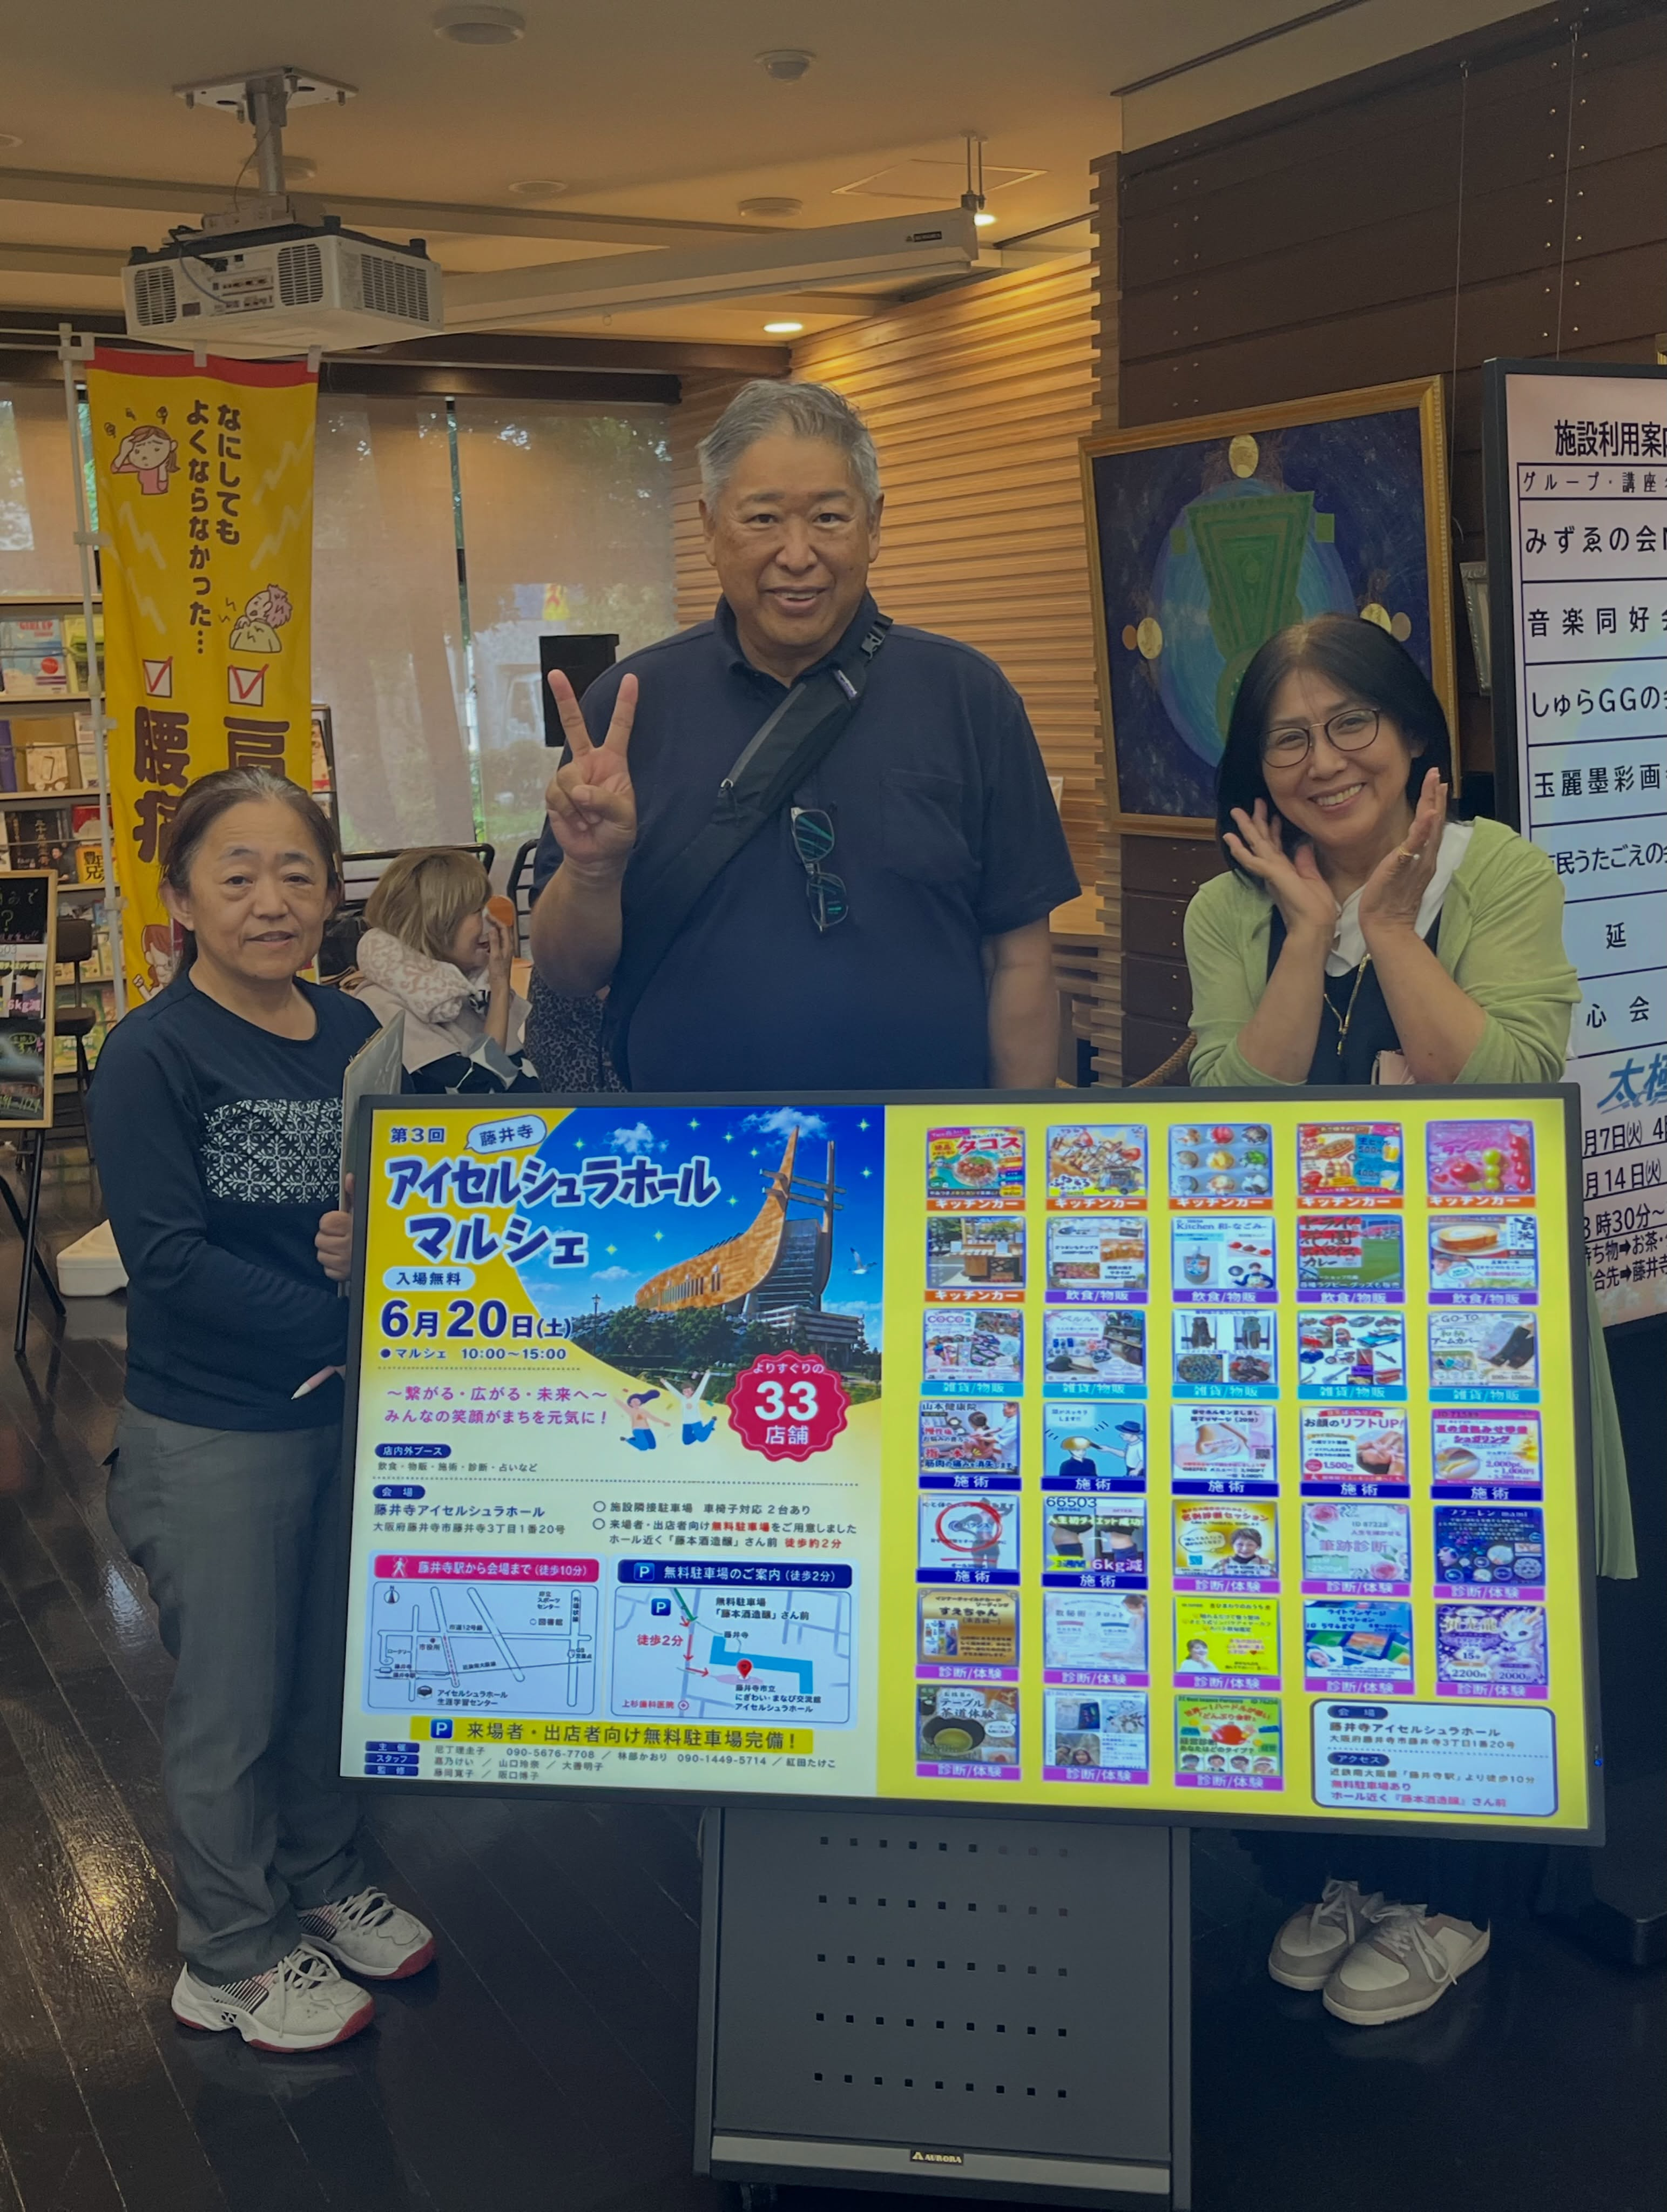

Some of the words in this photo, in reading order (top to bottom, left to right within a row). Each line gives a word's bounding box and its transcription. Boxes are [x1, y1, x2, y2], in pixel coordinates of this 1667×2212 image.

[1554, 419, 1667, 458] 施設利用案
[217, 404, 241, 546] なにしても
[1523, 471, 1667, 494] グループ・講座
[1532, 685, 1667, 718] しゅらGGの
[1534, 763, 1667, 799] 玉麗墨彩画
[1547, 842, 1667, 875] 民うたごえの
[1605, 921, 1627, 950] 延
[390, 1127, 445, 1144] 第3回
[480, 1123, 534, 1147] 藤井寺
[956, 1136, 1022, 1155] タコス
[388, 1158, 718, 1206] アイセルシュラホール
[935, 1199, 1019, 1209] キッチンカー
[1055, 1199, 1140, 1209] キッチンカー
[1177, 1197, 1264, 1208] キッチンカー
[1301, 1196, 1391, 1206] キッチンカー
[1429, 1195, 1521, 1206] キッチンカー
[408, 1216, 586, 1265] マルシェ
[396, 1272, 461, 1286] 入場無料
[935, 1291, 1019, 1300] キッチンカー
[1065, 1290, 1130, 1301] 飲食/物販
[1192, 1291, 1257, 1303] 飲食/物販
[1321, 1292, 1387, 1303] 飲食/物販
[1453, 1293, 1520, 1305] 飲食/物販
[380, 1299, 572, 1338] 6月20日(土)
[395, 1348, 447, 1359] マルシェ
[752, 1362, 825, 1375] よりすぐりの
[942, 1382, 1005, 1393] 雑貨/物販
[1062, 1382, 1126, 1394] 雑貨/物販
[1193, 1386, 1258, 1397] 雑貨/物販
[1320, 1386, 1386, 1398] 雑貨/物販
[754, 1380, 819, 1421] 33
[1453, 1390, 1520, 1401] 雑貨/物販
[765, 1425, 809, 1445] 店舗
[383, 1446, 443, 1456] 店内外ブース
[954, 1475, 989, 1488] 施術
[1075, 1478, 1111, 1491] 施術
[1208, 1480, 1245, 1493] 施術
[1341, 1483, 1378, 1496] 施術
[1470, 1487, 1510, 1500] 施術
[610, 1502, 693, 1514] 施設隣接駐車場
[1046, 1497, 1097, 1507] 66503
[373, 1503, 545, 1518] 藤井寺アイセルシュラホール
[954, 1570, 990, 1583] 施術
[1080, 1575, 1116, 1588] 施術
[1194, 1580, 1261, 1593] 診断/体験
[1326, 1581, 1394, 1594] 診断/体験
[1451, 1586, 1520, 1600] 診断/体験
[716, 1597, 766, 1607] 無料駐車場
[939, 1607, 998, 1617] すえちゃん
[637, 1634, 684, 1647] 徒歩2分
[938, 1666, 1003, 1679] 診断/体験
[1062, 1671, 1126, 1684] 診断/体験
[1194, 1676, 1260, 1690] 診断/体験
[1326, 1679, 1394, 1694] 診断/体験
[437, 1689, 508, 1699] アイセルシュラホール
[1458, 1684, 1526, 1697] 診断/体験
[734, 1703, 814, 1713] アイセルシュラホール
[940, 1698, 984, 1707] テーブル
[941, 1708, 995, 1719] 茶道体験
[467, 1721, 795, 1750] 来場者・出店者向け無料駐車場完備！
[1329, 1722, 1501, 1737] 藤井寺アイセルシュラホール
[376, 1754, 408, 1764] スタッフ
[506, 1748, 595, 1759] 090-5676-7708
[677, 1752, 767, 1766] 090-1449-5714
[1337, 1755, 1381, 1764] アクセス
[937, 1764, 1002, 1777] 診断/体験
[1065, 1769, 1131, 1782] 診断/体験
[1196, 1775, 1264, 1789] 診断/体験
[924, 2154, 962, 2163] AURORA
